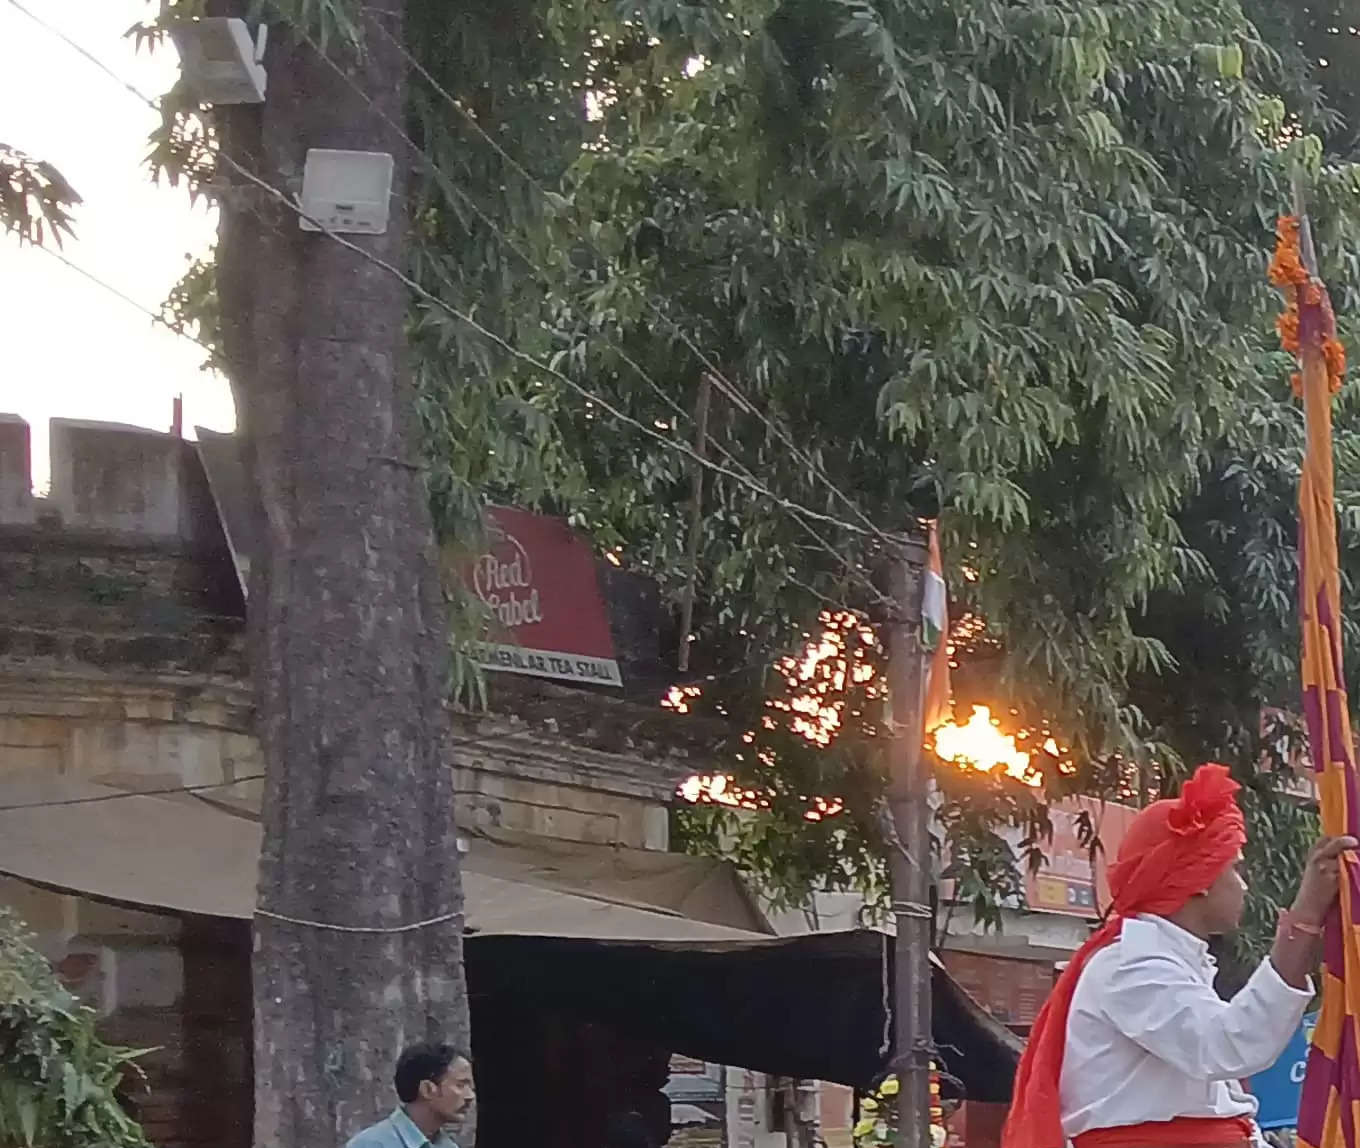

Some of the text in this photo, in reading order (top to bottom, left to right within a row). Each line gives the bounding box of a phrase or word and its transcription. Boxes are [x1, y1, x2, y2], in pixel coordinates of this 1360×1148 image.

[481, 552, 529, 591] Red
[548, 657, 573, 674] TEA
[576, 661, 613, 680] STALL
